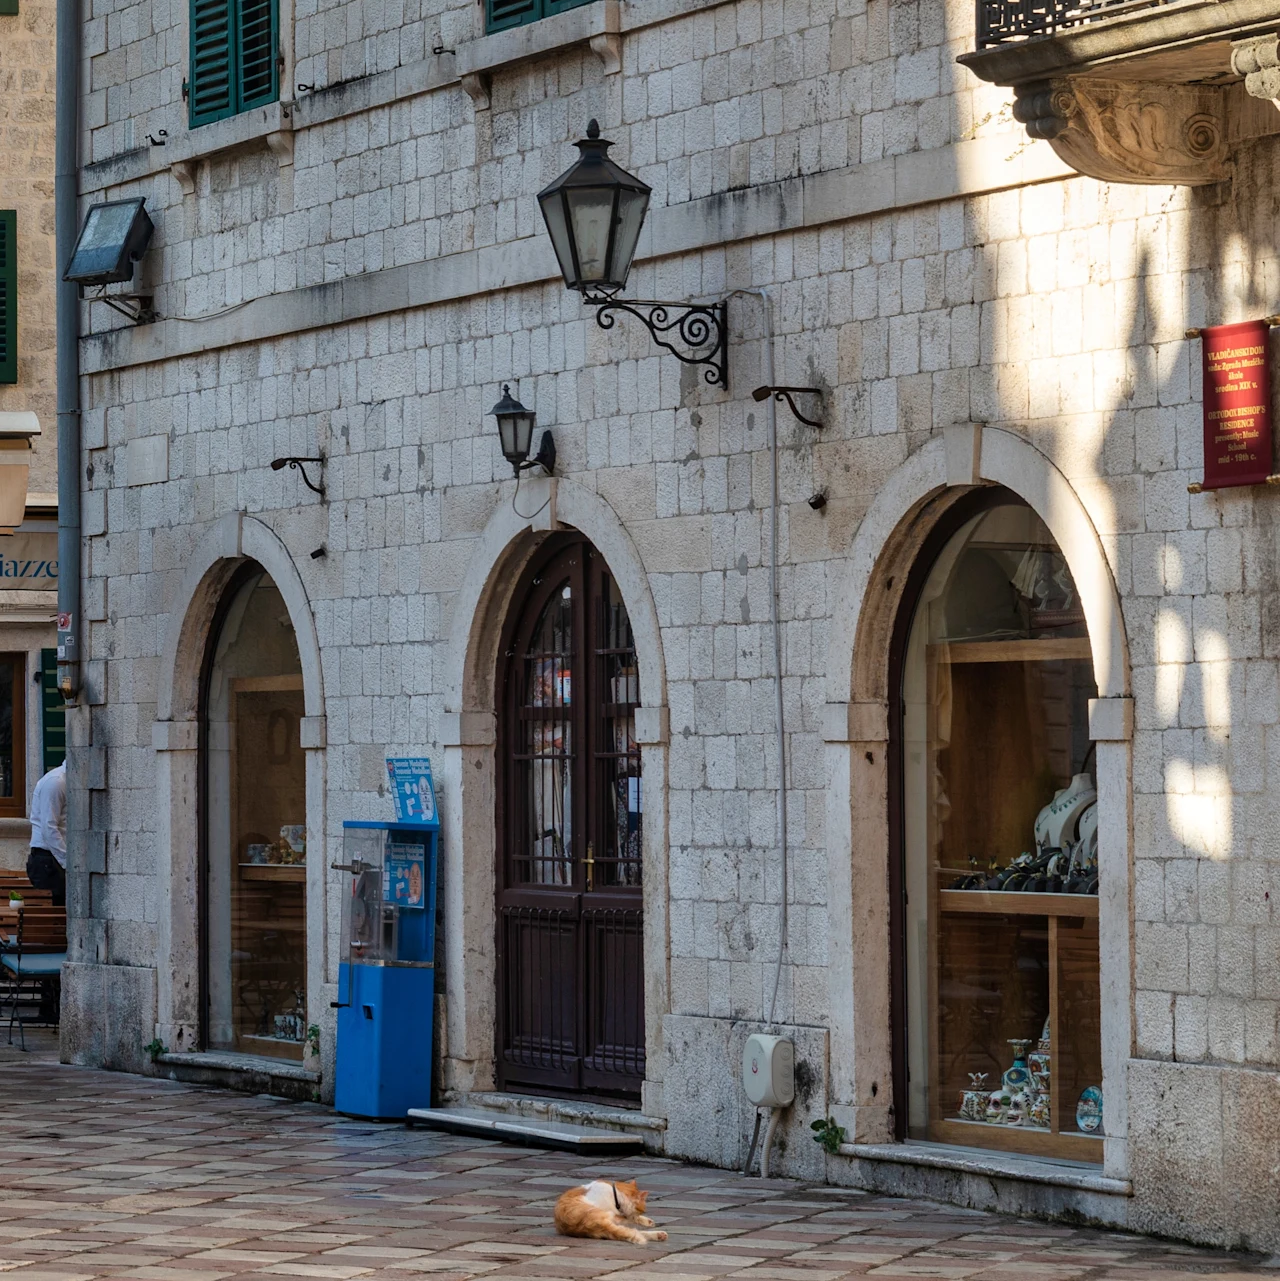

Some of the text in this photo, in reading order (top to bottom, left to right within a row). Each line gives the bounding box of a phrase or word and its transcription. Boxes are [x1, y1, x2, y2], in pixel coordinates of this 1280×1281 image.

[1208, 346, 1264, 361] VLADIČANSKI DOM
[1239, 381, 1251, 390] XIX
[1220, 418, 1254, 430] RESIDENCE
